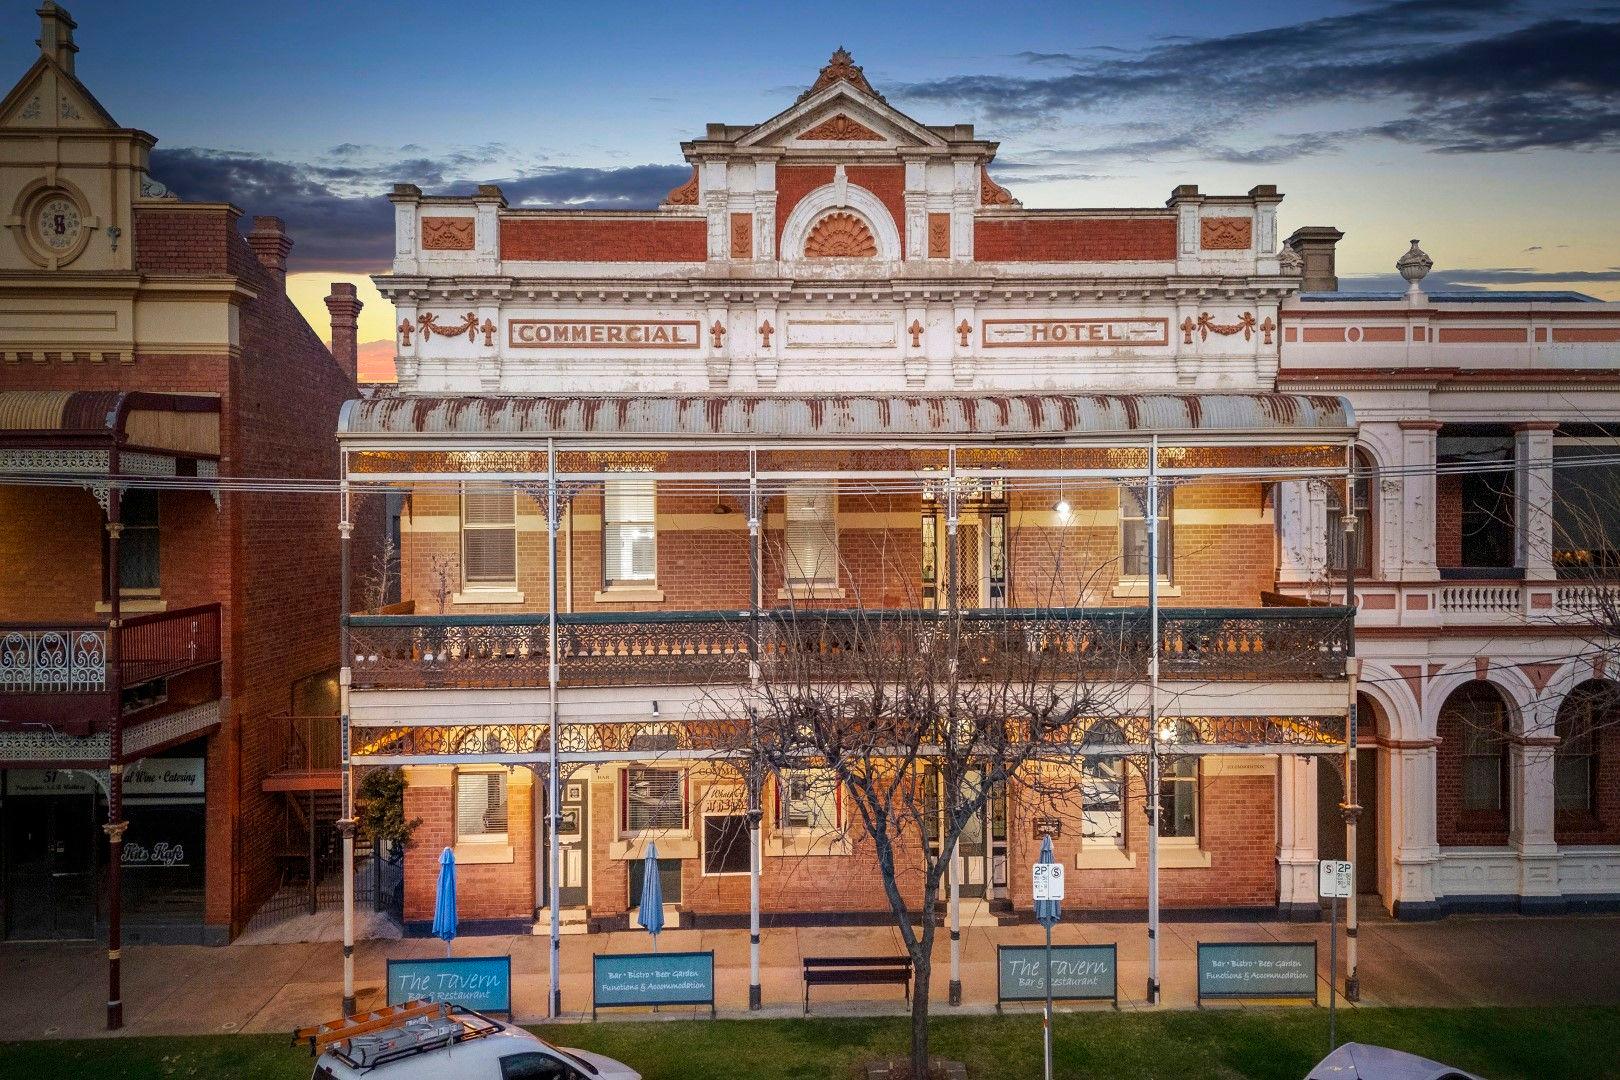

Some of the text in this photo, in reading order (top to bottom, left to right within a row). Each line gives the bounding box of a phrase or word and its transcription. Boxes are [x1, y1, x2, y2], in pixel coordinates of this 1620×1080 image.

[517, 325, 687, 342] COMMERCIAL
[1031, 324, 1122, 342] HOTEL
[163, 770, 196, 786] Catering
[1034, 866, 1048, 876] 2P
[1337, 863, 1352, 873] 2P
[1009, 958, 1040, 976] The
[1211, 960, 1226, 968] Bar
[1230, 959, 1253, 968] Bistro
[1274, 959, 1302, 969] Garden
[607, 968, 699, 980] Bar Bistro Beer Garden
[1205, 971, 1242, 979] Functions
[399, 972, 501, 991] The Tavern
[601, 981, 706, 993] Functions & Accommodation
[1018, 977, 1036, 987] Bar
[437, 990, 490, 1000] Restaurant
